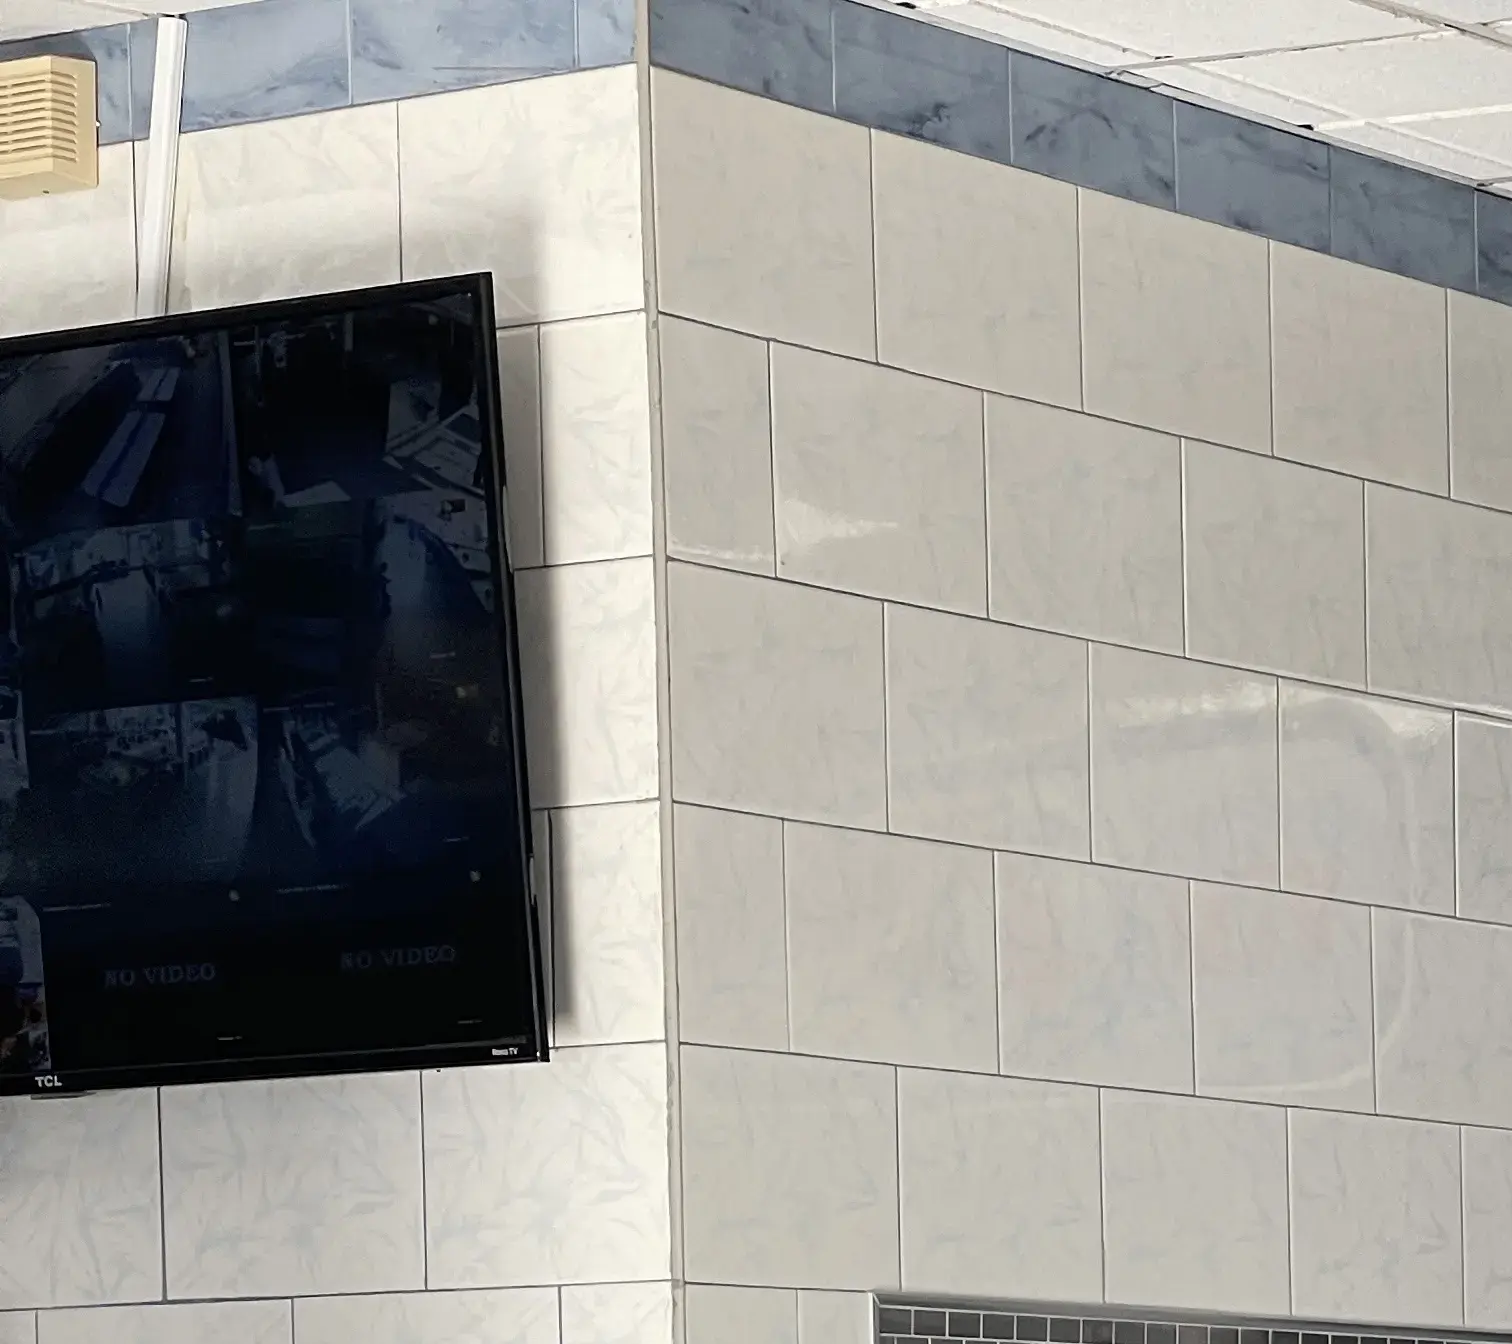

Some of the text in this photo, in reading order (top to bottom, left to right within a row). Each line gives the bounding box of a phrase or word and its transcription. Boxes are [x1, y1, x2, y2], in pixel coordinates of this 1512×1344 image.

[340, 944, 456, 971] NO VIDEO
[103, 963, 217, 990] NO VIDEO
[34, 1075, 62, 1088] TCL
